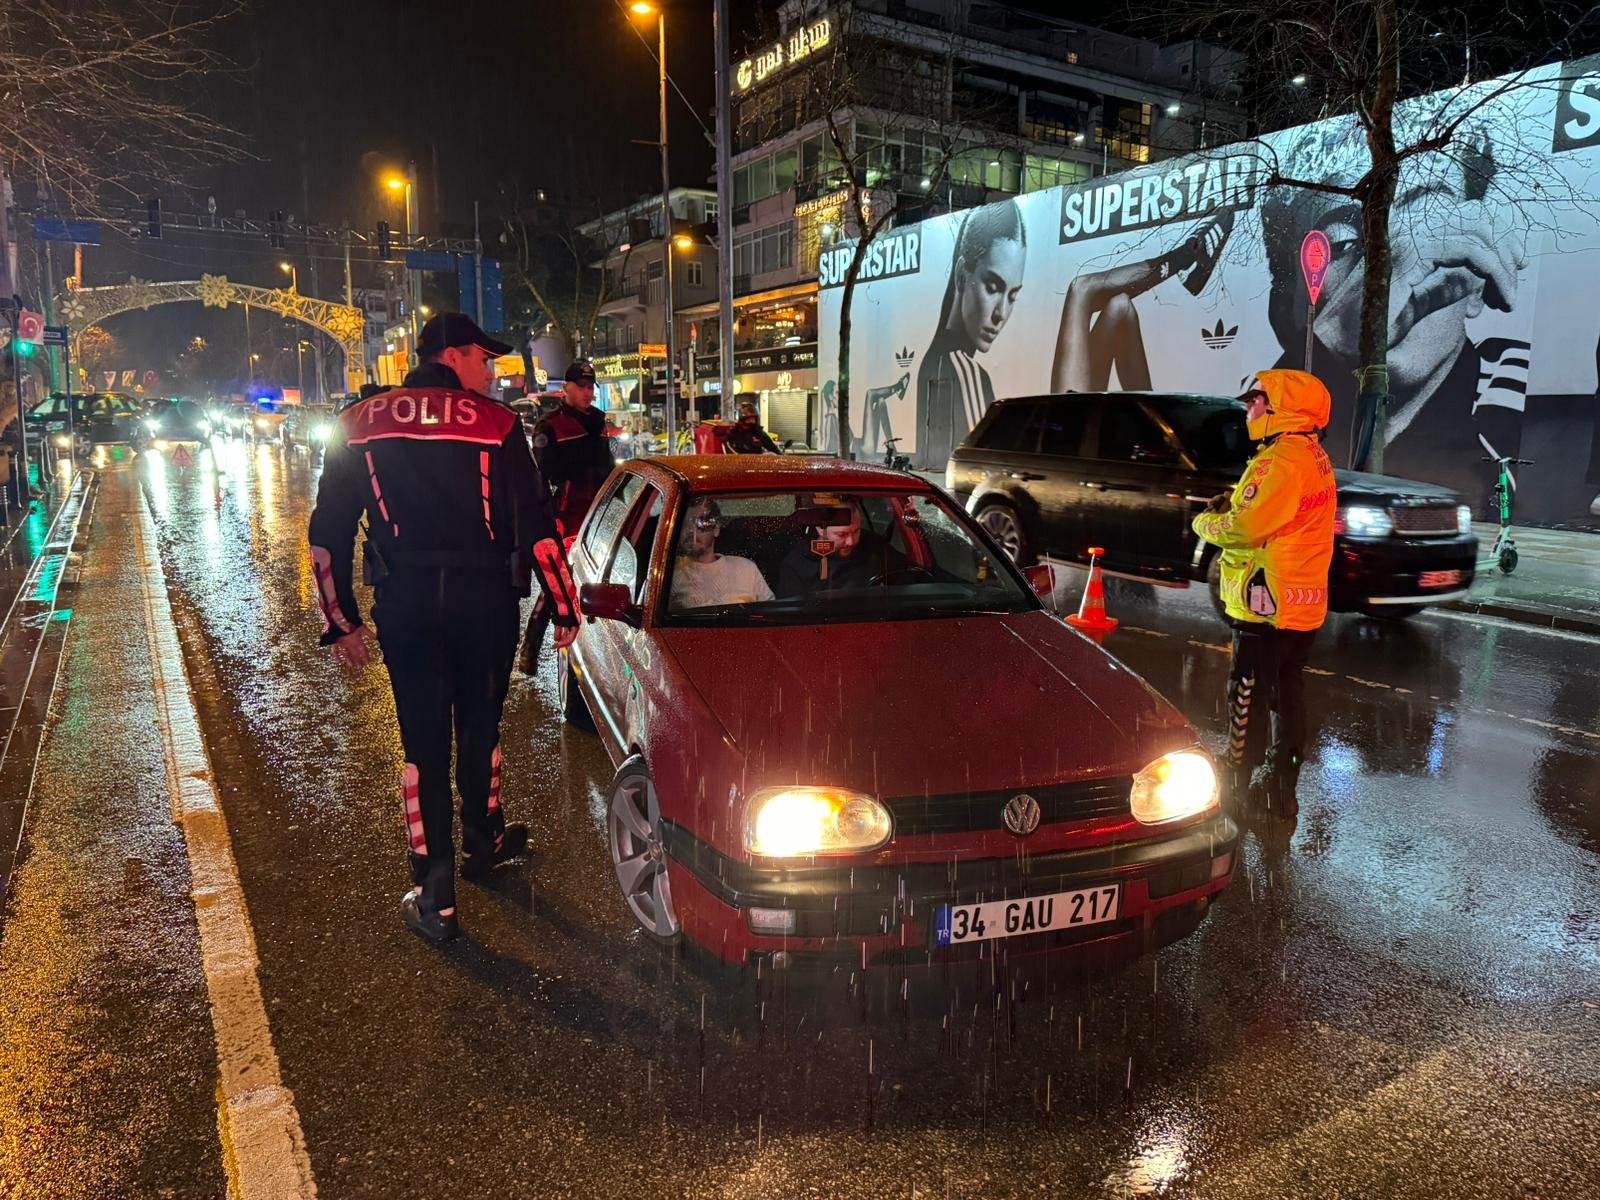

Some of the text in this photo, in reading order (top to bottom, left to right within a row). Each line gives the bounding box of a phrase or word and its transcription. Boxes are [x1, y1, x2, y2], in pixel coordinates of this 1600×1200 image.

[1063, 156, 1251, 238] SUPERSTAR
[819, 232, 919, 287] SUPRSTAR
[368, 393, 478, 425] POLİS
[937, 888, 1116, 941] TR 34 GAU 217
